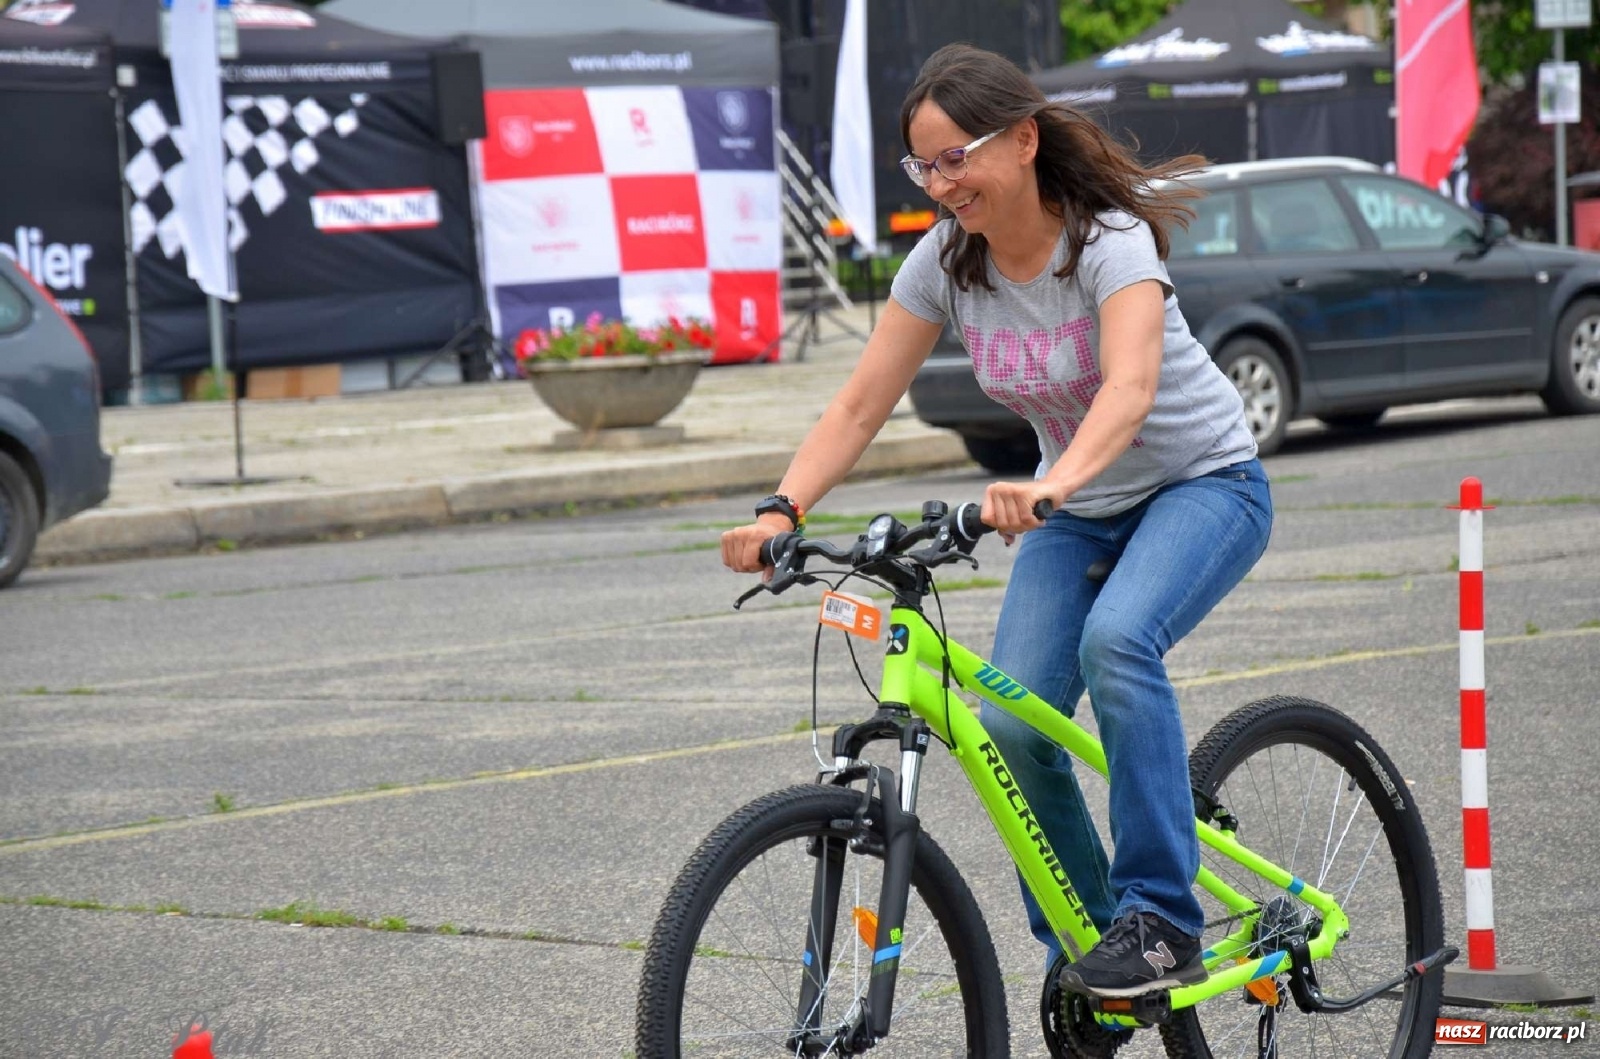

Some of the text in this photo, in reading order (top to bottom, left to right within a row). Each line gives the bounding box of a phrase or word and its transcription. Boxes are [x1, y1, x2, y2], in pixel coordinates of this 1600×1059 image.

[861, 614, 875, 631] M
[974, 662, 1028, 700] 100
[979, 740, 1095, 930] ROCKRIDER
[1143, 941, 1177, 979] N
